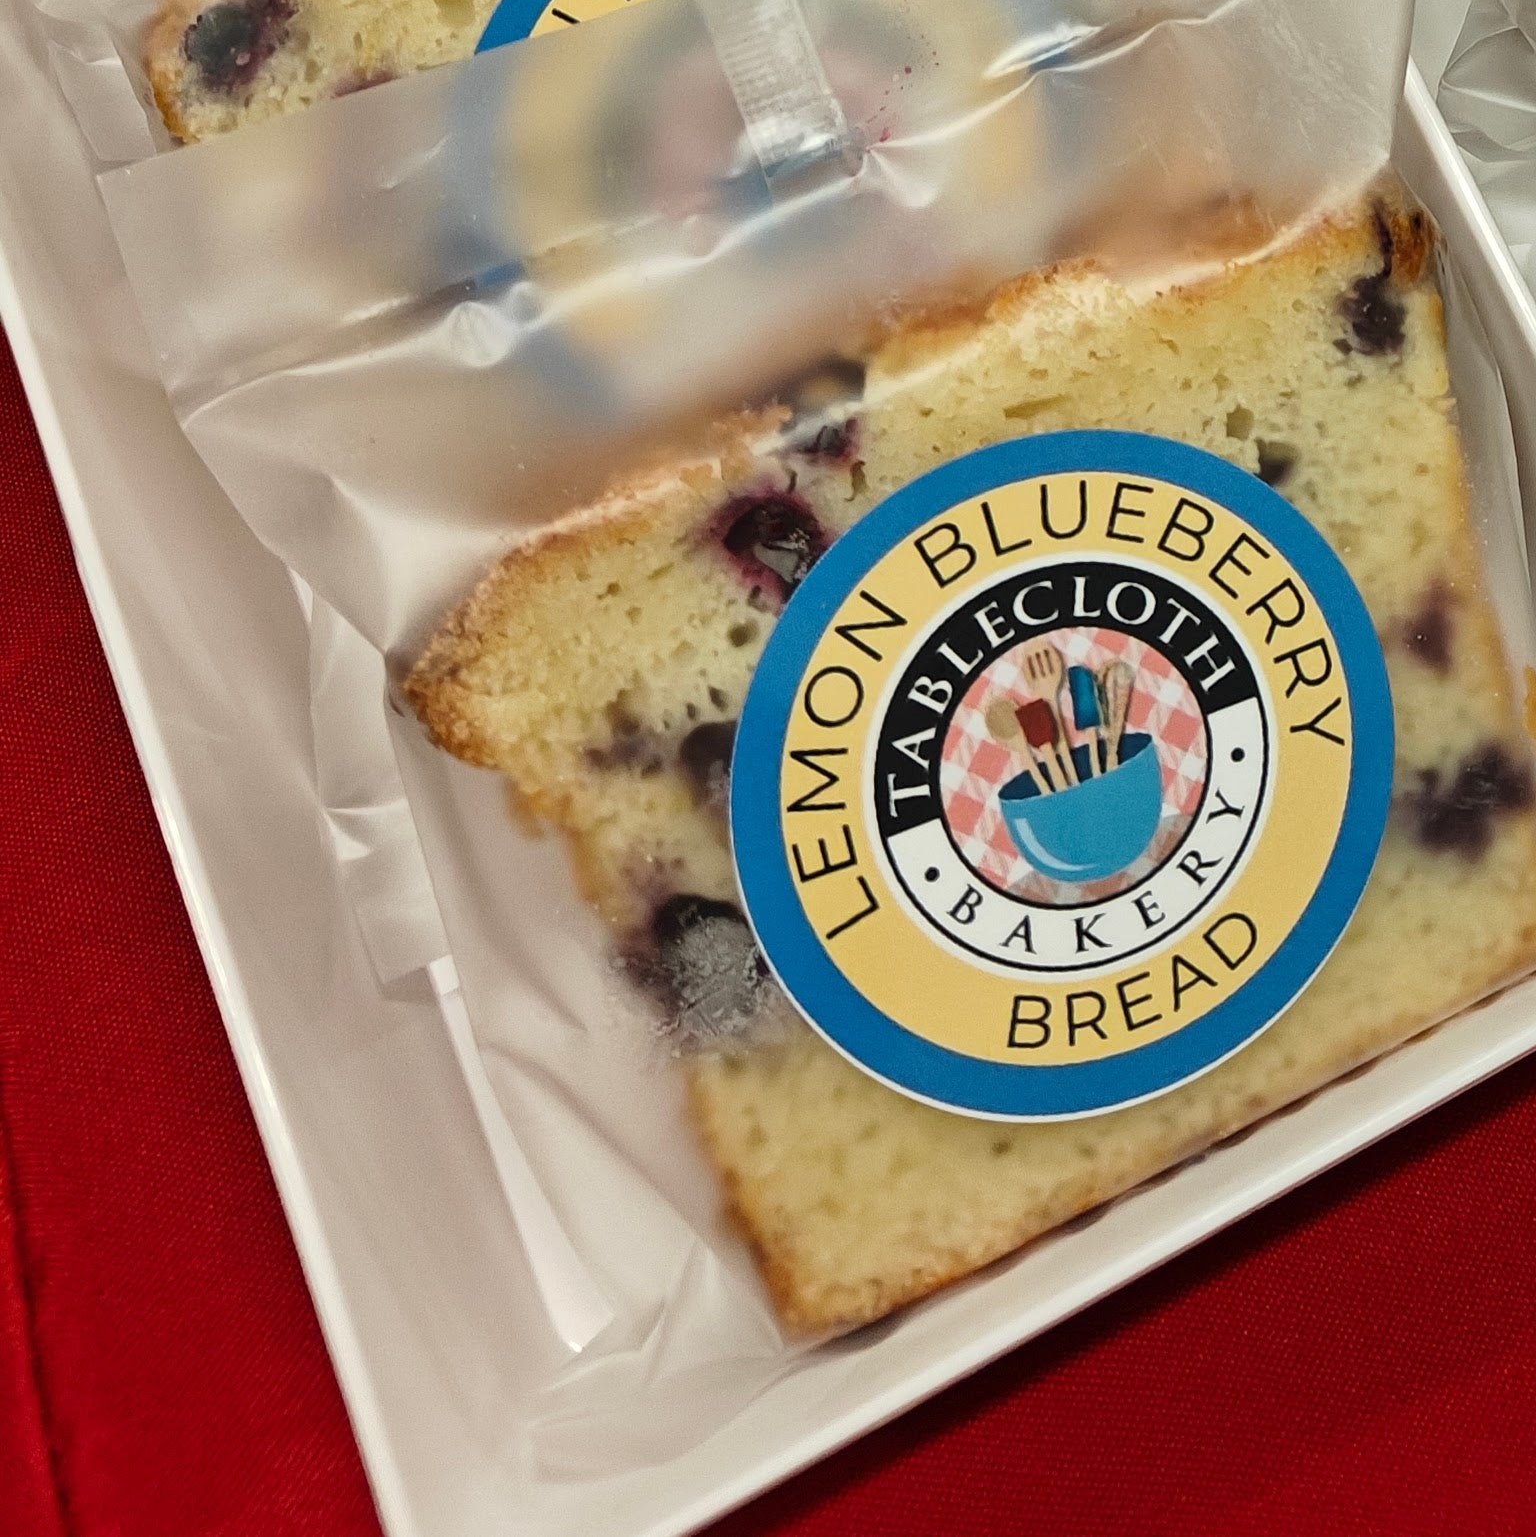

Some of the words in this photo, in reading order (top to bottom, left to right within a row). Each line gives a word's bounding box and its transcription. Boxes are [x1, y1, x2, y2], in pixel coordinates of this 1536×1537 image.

[786, 589, 908, 940] LEMON
[914, 479, 1346, 748] BLUEBERRY
[887, 576, 1236, 818] TABLECLOTH
[946, 792, 1245, 955] BAKERY
[1006, 912, 1258, 1048] BREAD
